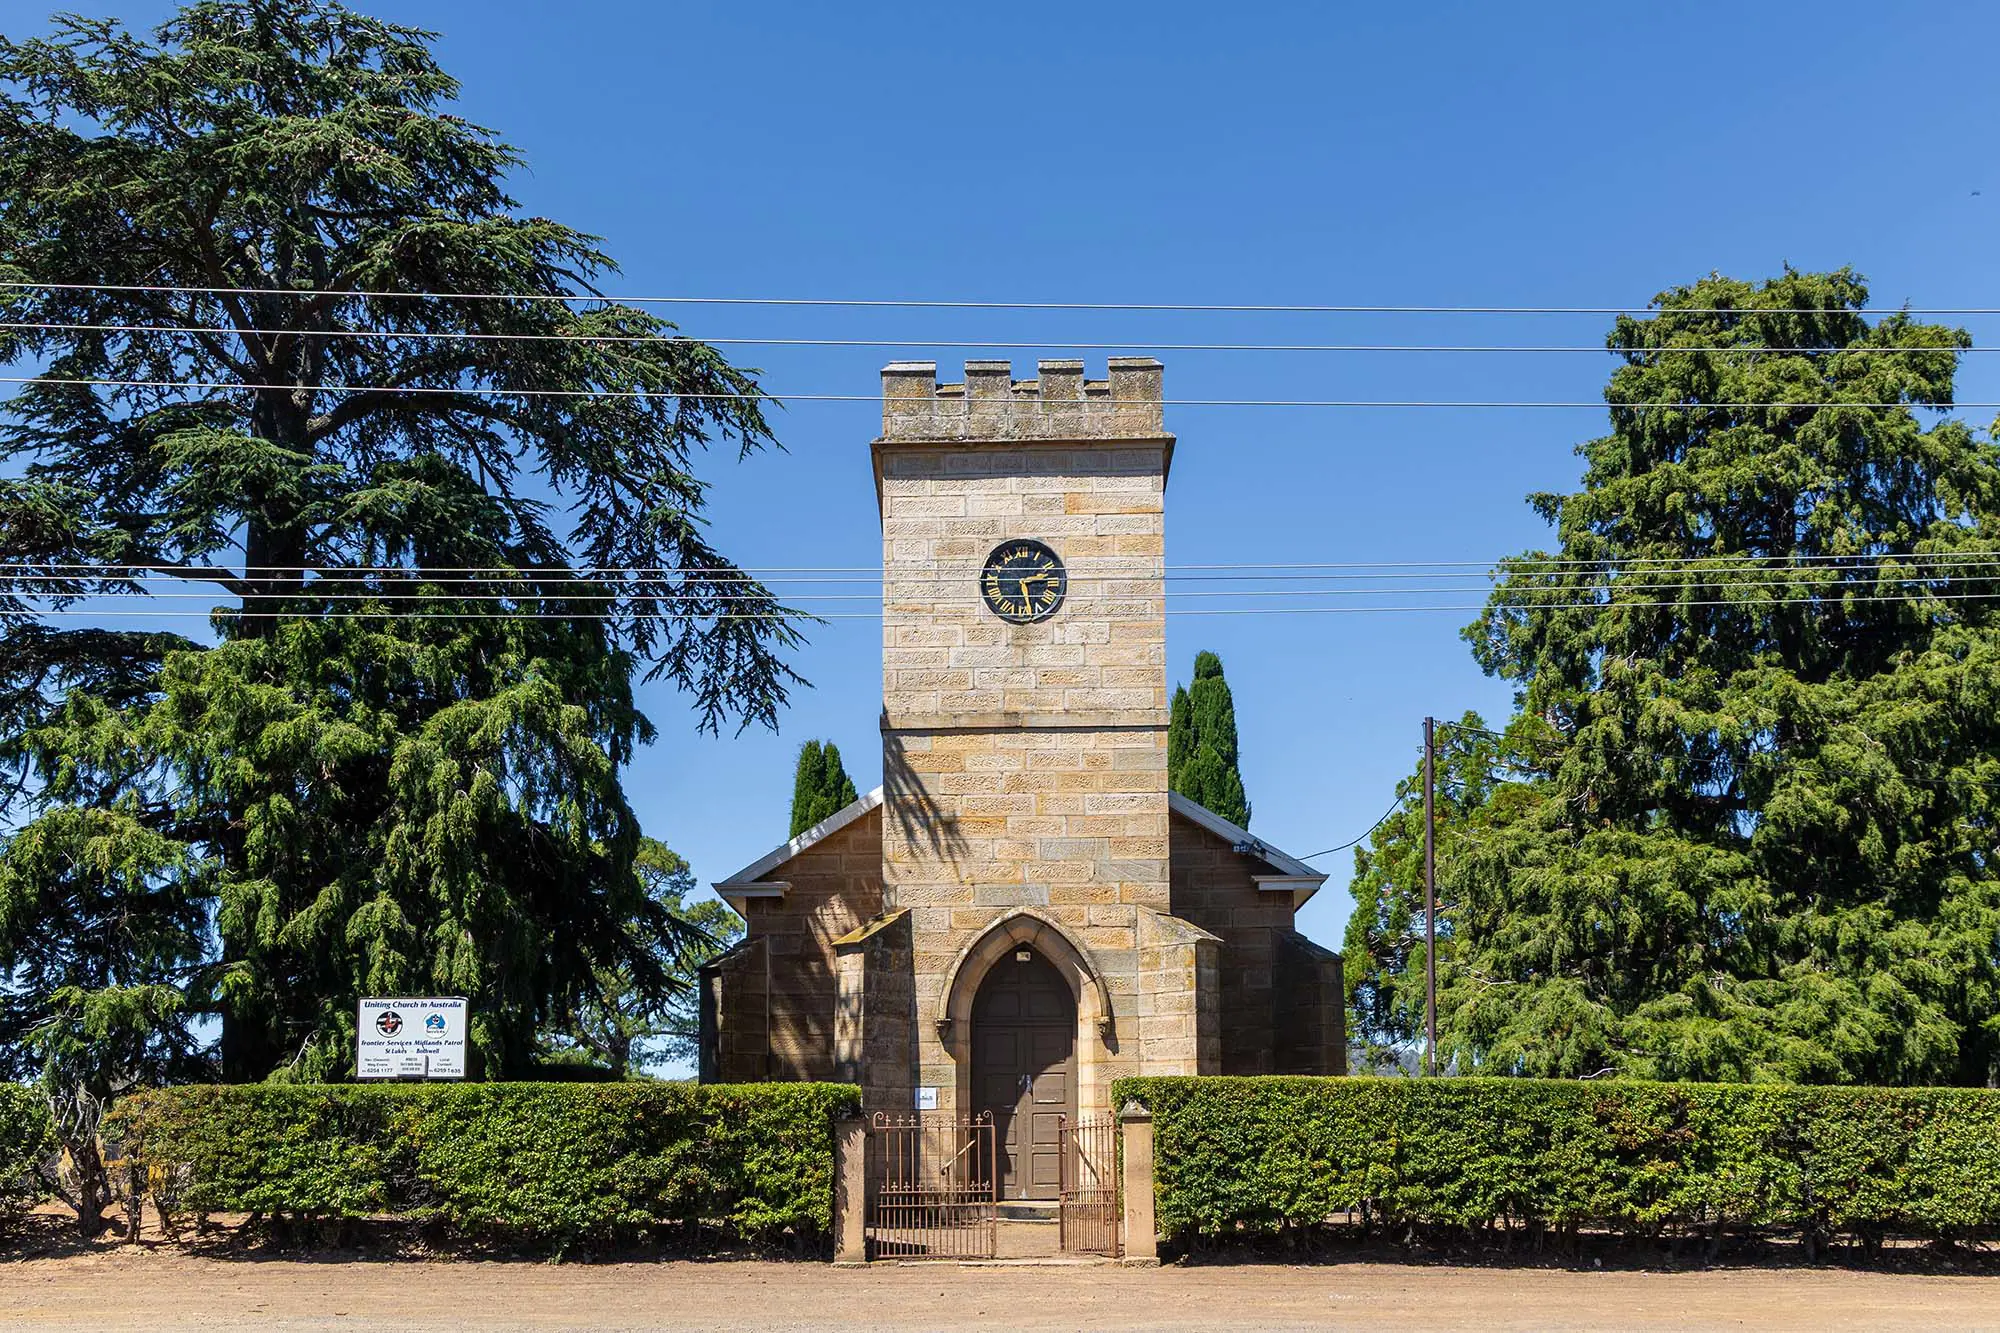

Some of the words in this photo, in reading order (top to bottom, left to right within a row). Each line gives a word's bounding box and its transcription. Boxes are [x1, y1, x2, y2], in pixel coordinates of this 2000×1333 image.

[1014, 546, 1028, 558] XII
[1034, 551, 1040, 560] I
[1043, 560, 1055, 571] II
[1047, 577, 1059, 587] III
[1000, 600, 1014, 615] VII
[1035, 602, 1044, 615] V
[364, 1001, 390, 1009] Uniting
